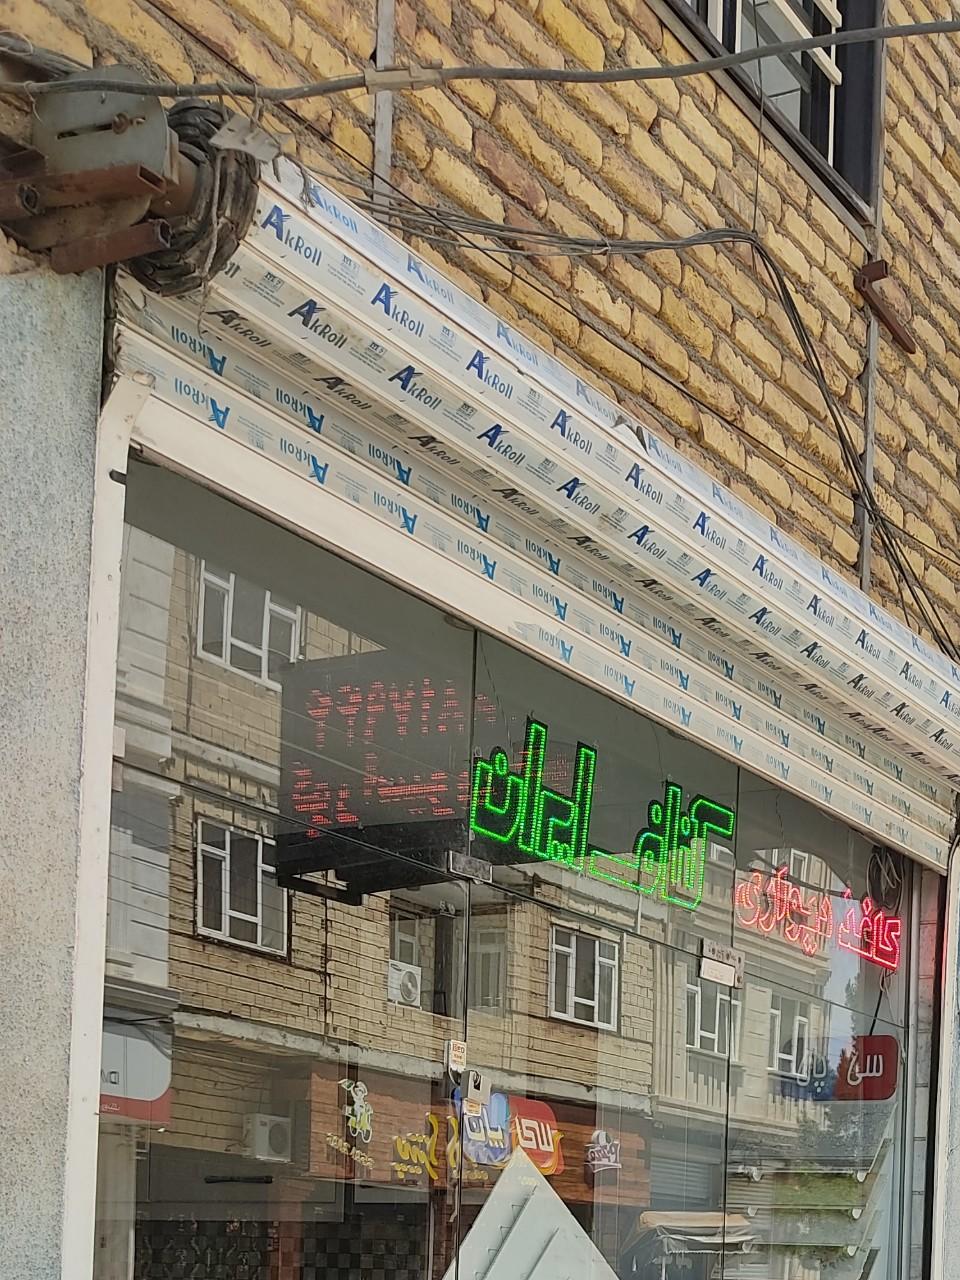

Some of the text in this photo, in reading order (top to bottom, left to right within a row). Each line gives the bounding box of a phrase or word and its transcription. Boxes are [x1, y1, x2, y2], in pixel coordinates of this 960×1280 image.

[171, 325, 227, 377] AkRoll
[276, 387, 325, 434] AkRoll
[368, 443, 412, 486] AkRoll
[451, 493, 490, 533] AkRoll
[525, 538, 561, 576] AkRoll
[174, 378, 230, 430] AkRoll
[280, 437, 329, 485] AkRoll
[373, 491, 418, 535] AkRoll
[457, 539, 497, 580] AkRoll
[532, 583, 568, 621] AkRoll
[205, 309, 272, 348] AkRoll
[313, 376, 372, 410] AkRoll
[408, 435, 462, 466] AkRoll
[491, 487, 540, 516] AkRoll
[261, 204, 322, 266] AkRoll
[371, 282, 425, 338] AkRoll
[465, 350, 514, 399] AkRoll
[550, 408, 593, 455] AkRoll
[625, 462, 663, 505] AkRoll
[692, 511, 727, 550] AkRoll
[752, 554, 784, 591] AkRoll
[287, 298, 348, 350] AkRoll
[388, 364, 442, 410] AkRoll
[477, 423, 526, 465] AkRoll
[556, 477, 601, 515] AkRoll
[627, 524, 667, 560] AkRoll
[691, 567, 728, 600] AkRoll
[749, 607, 782, 636] AkRoll
[469, 721, 597, 872] ایران
[735, 866, 901, 970] کاغذ دیواری
